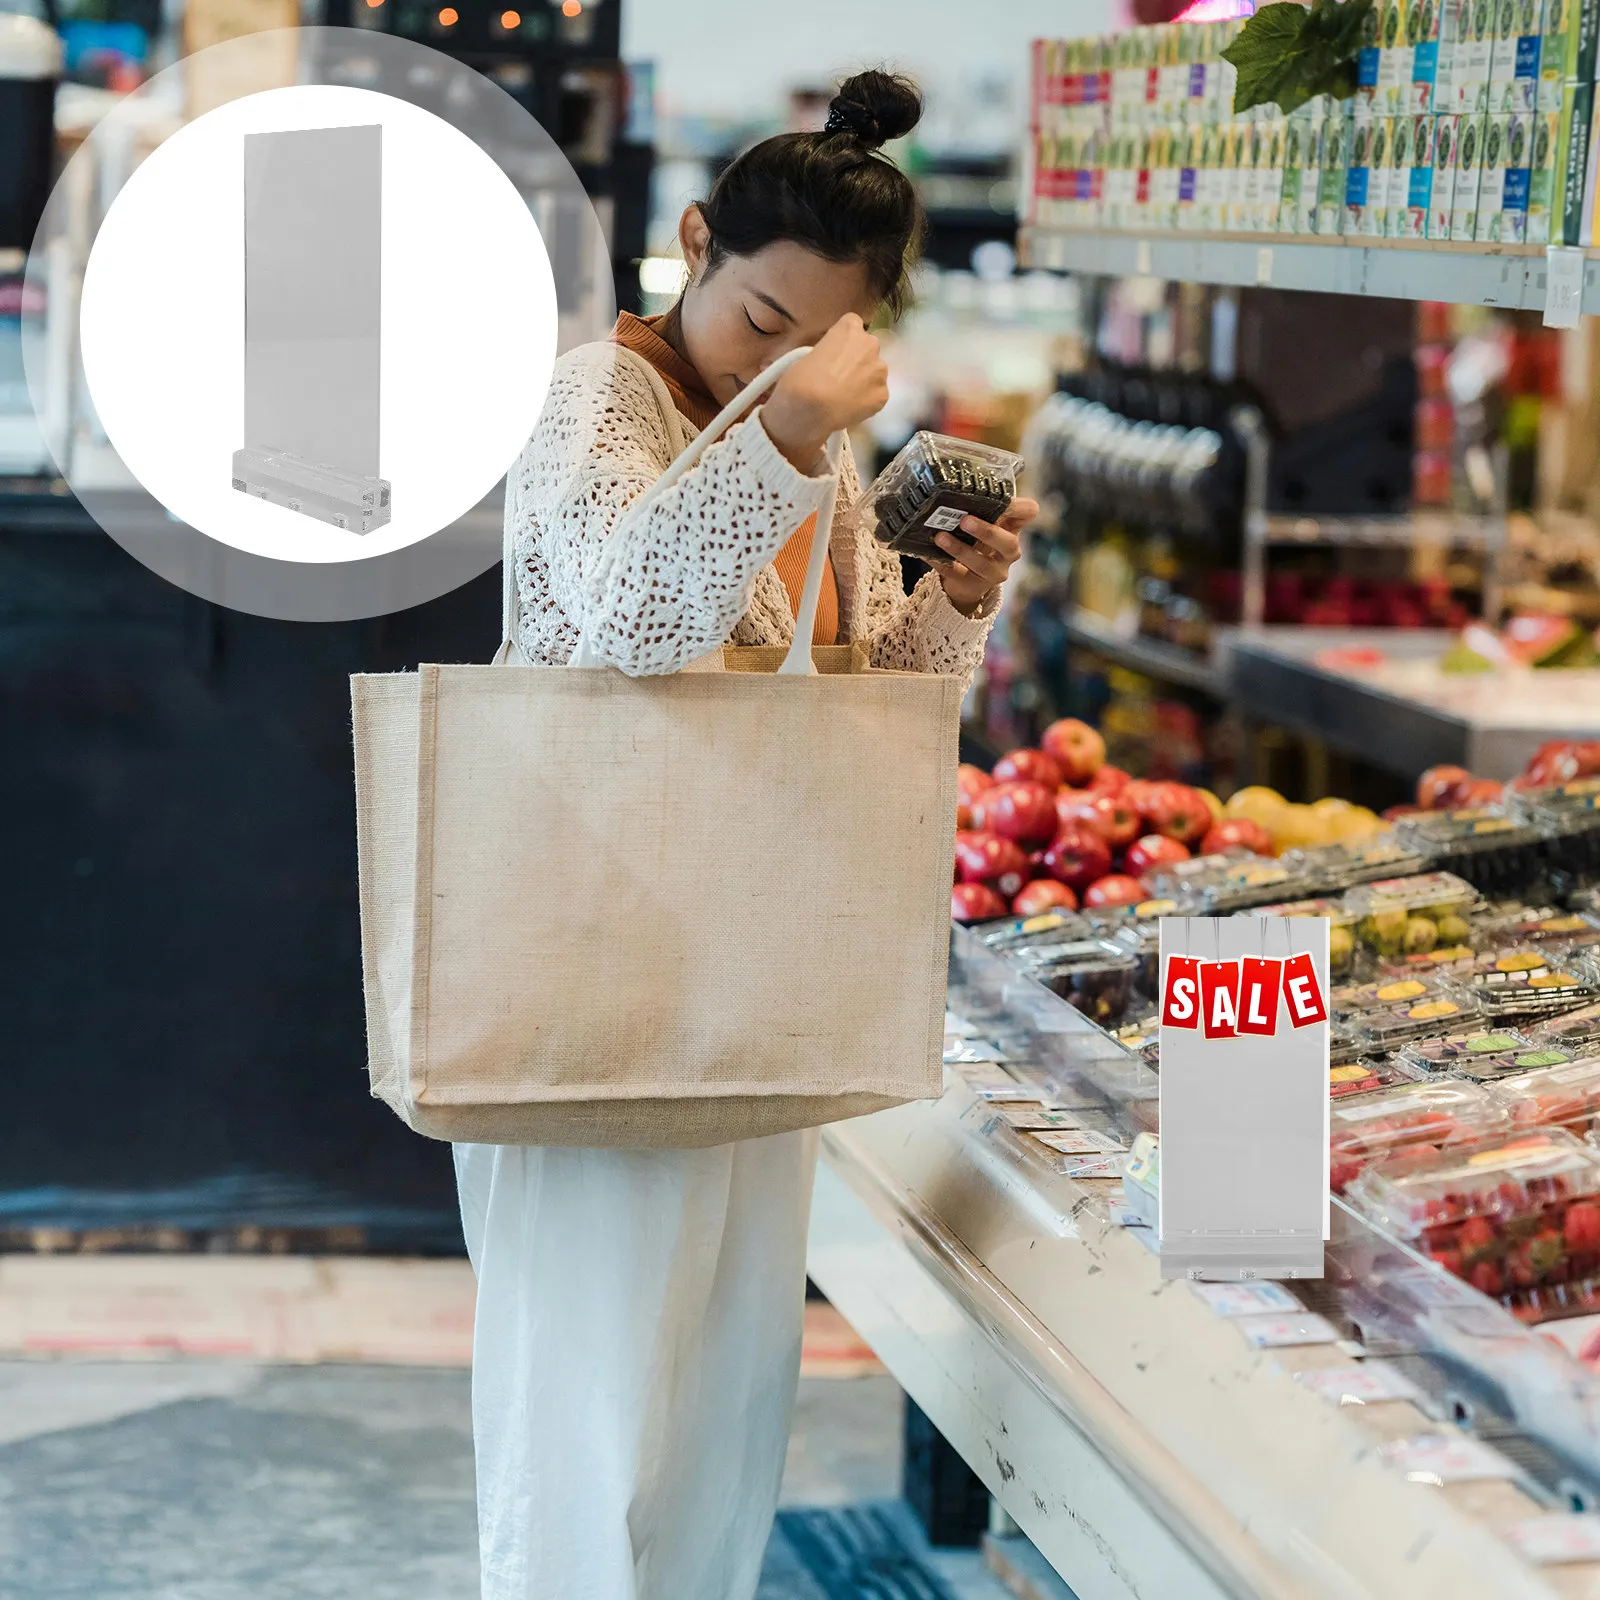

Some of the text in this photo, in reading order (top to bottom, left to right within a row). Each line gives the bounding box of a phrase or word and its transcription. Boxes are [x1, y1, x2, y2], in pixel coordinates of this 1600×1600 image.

[1564, 109, 1580, 216] GREEN TEA
[1170, 975, 1319, 1028] SALE
